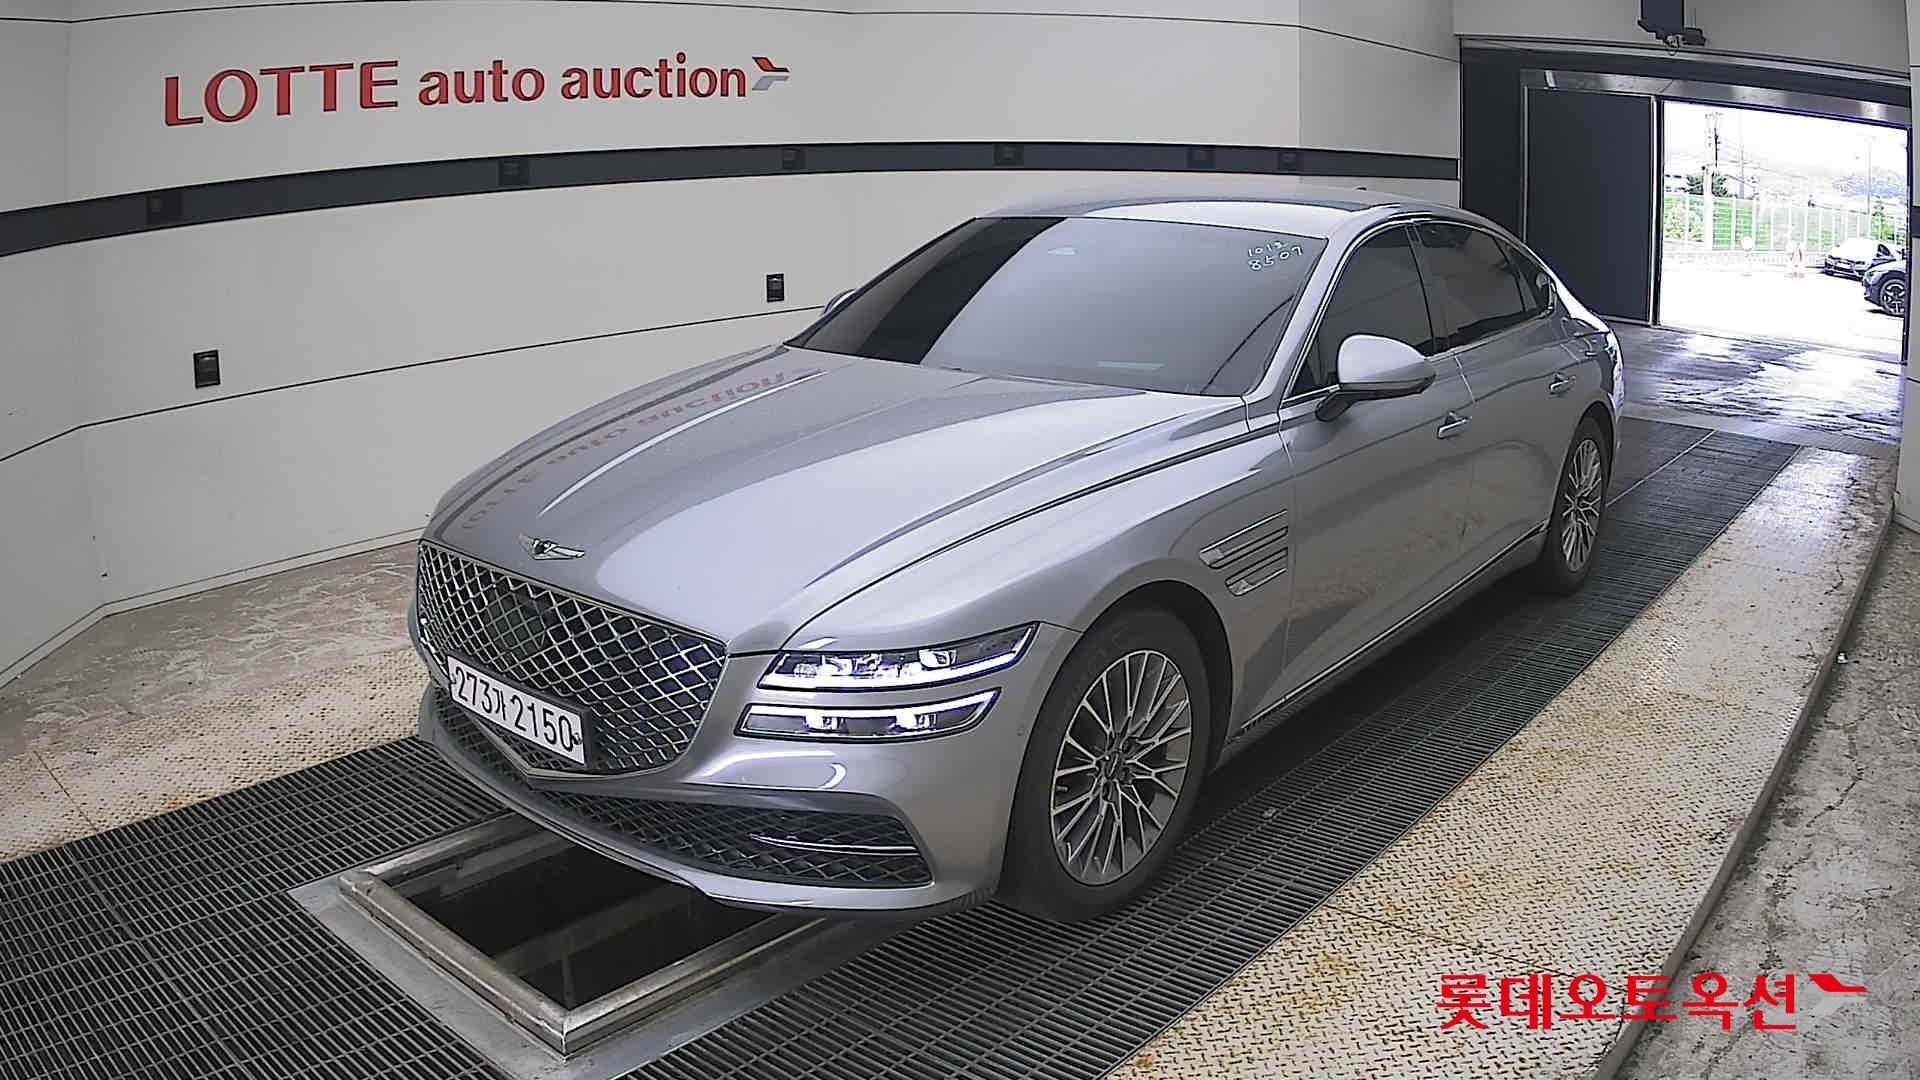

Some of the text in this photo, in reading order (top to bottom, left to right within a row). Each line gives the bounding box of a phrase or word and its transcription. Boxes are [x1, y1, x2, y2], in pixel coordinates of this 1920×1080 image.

[164, 52, 746, 126] LOTTE auto auction
[1248, 245, 1302, 270] 8507
[455, 666, 574, 752] 273가 2150
